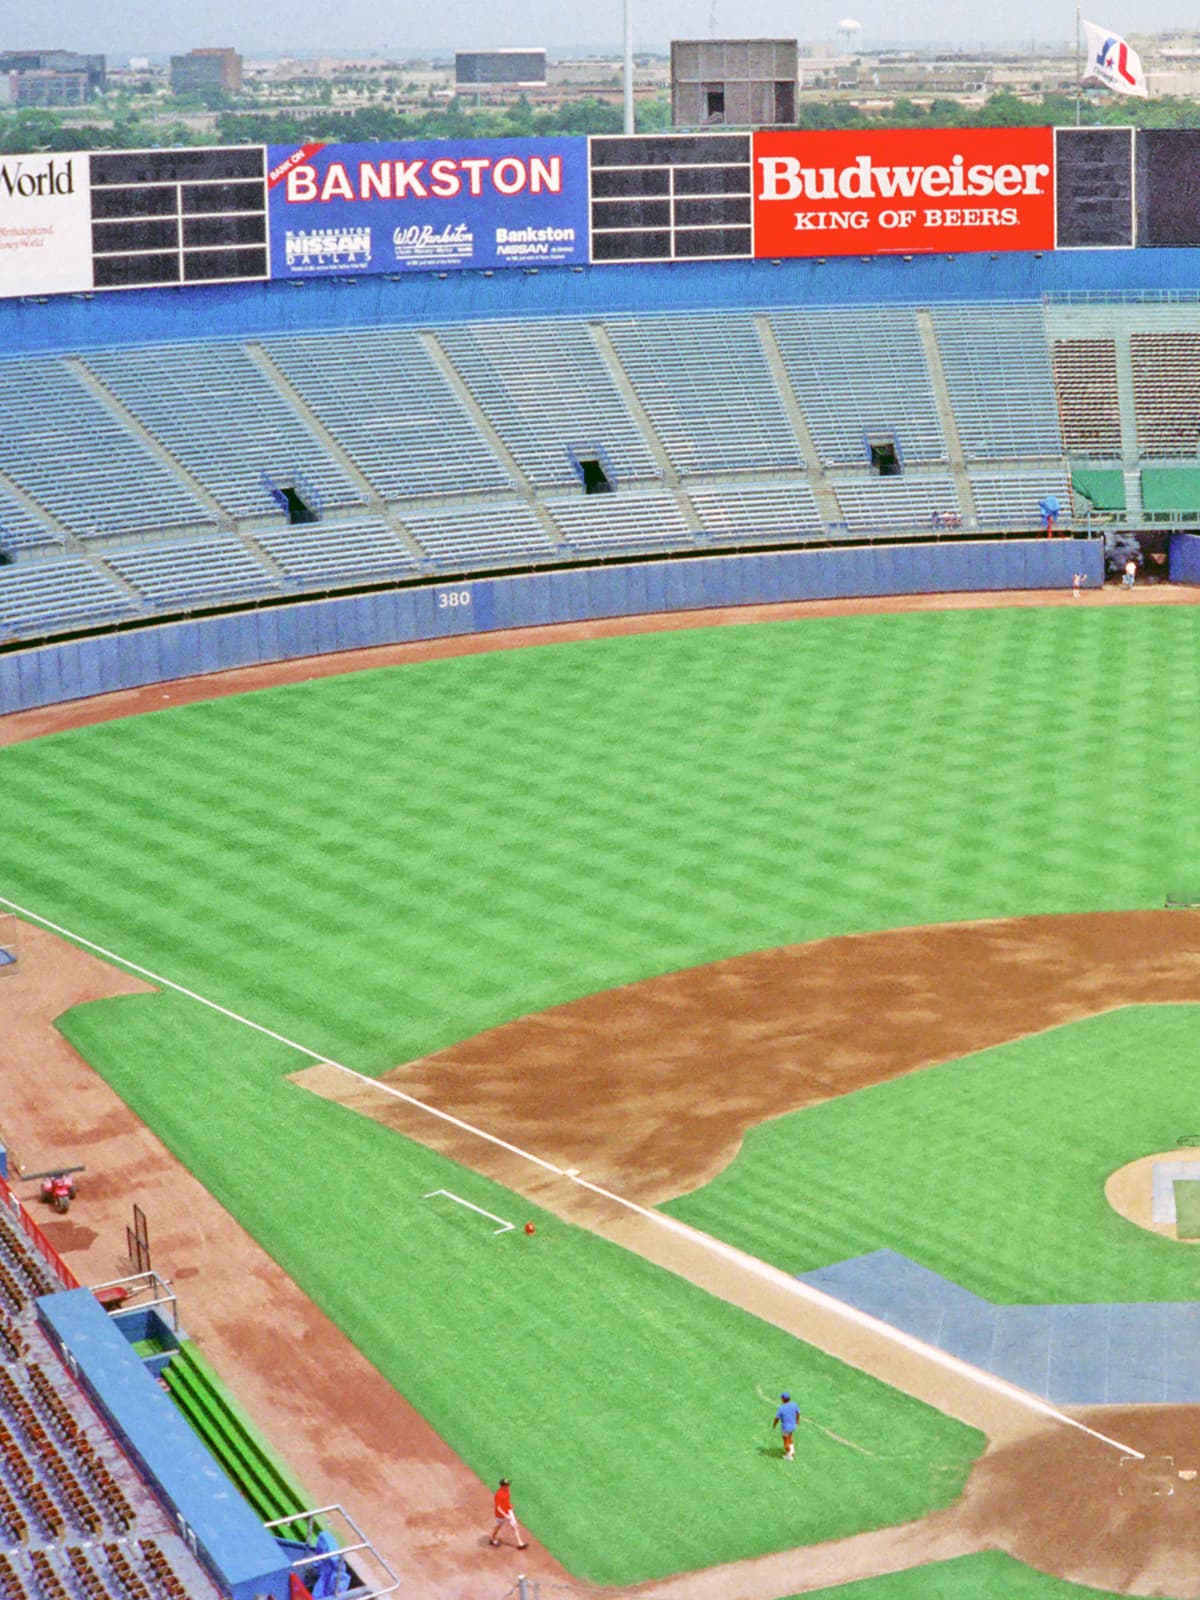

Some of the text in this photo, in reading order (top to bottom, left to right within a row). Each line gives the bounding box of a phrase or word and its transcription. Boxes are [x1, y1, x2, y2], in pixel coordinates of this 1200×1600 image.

[270, 149, 305, 180] BANK ON
[286, 156, 563, 204] BANKSTON
[758, 154, 1049, 200] Budweiser
[794, 211, 870, 230] KING
[878, 210, 917, 229] OF
[496, 227, 575, 243] Bankston
[286, 236, 370, 254] NISSAN
[496, 243, 549, 256] NISSAN
[286, 252, 372, 265] DALLAS
[439, 591, 471, 608] 380
